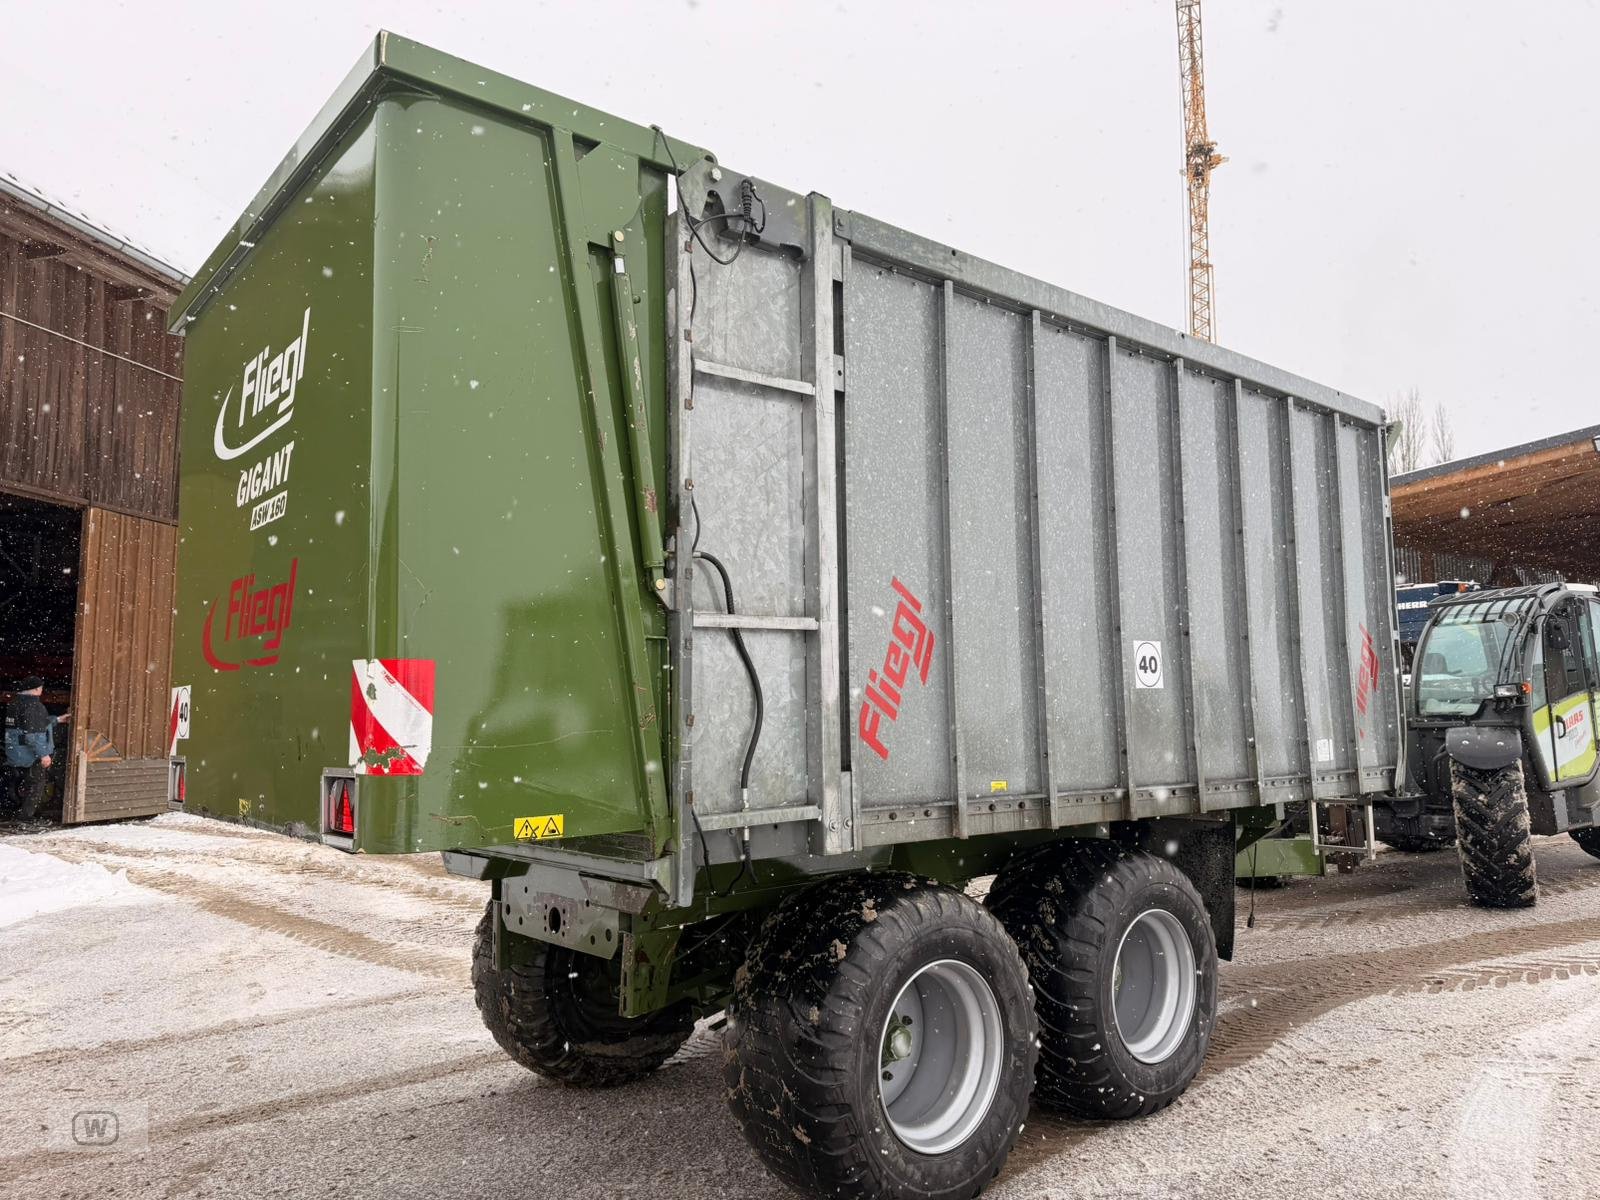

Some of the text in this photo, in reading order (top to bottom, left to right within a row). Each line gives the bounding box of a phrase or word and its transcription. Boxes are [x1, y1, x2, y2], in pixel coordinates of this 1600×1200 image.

[238, 306, 311, 428] Fliegl
[236, 440, 295, 508] GIGANT
[251, 494, 286, 528] ASW 160
[223, 557, 298, 651] Fliegl
[858, 575, 929, 762] Fliegl
[1139, 655, 1158, 674] 40
[1356, 623, 1375, 739] liegl
[179, 701, 189, 723] 40
[1564, 710, 1584, 730] LAAS
